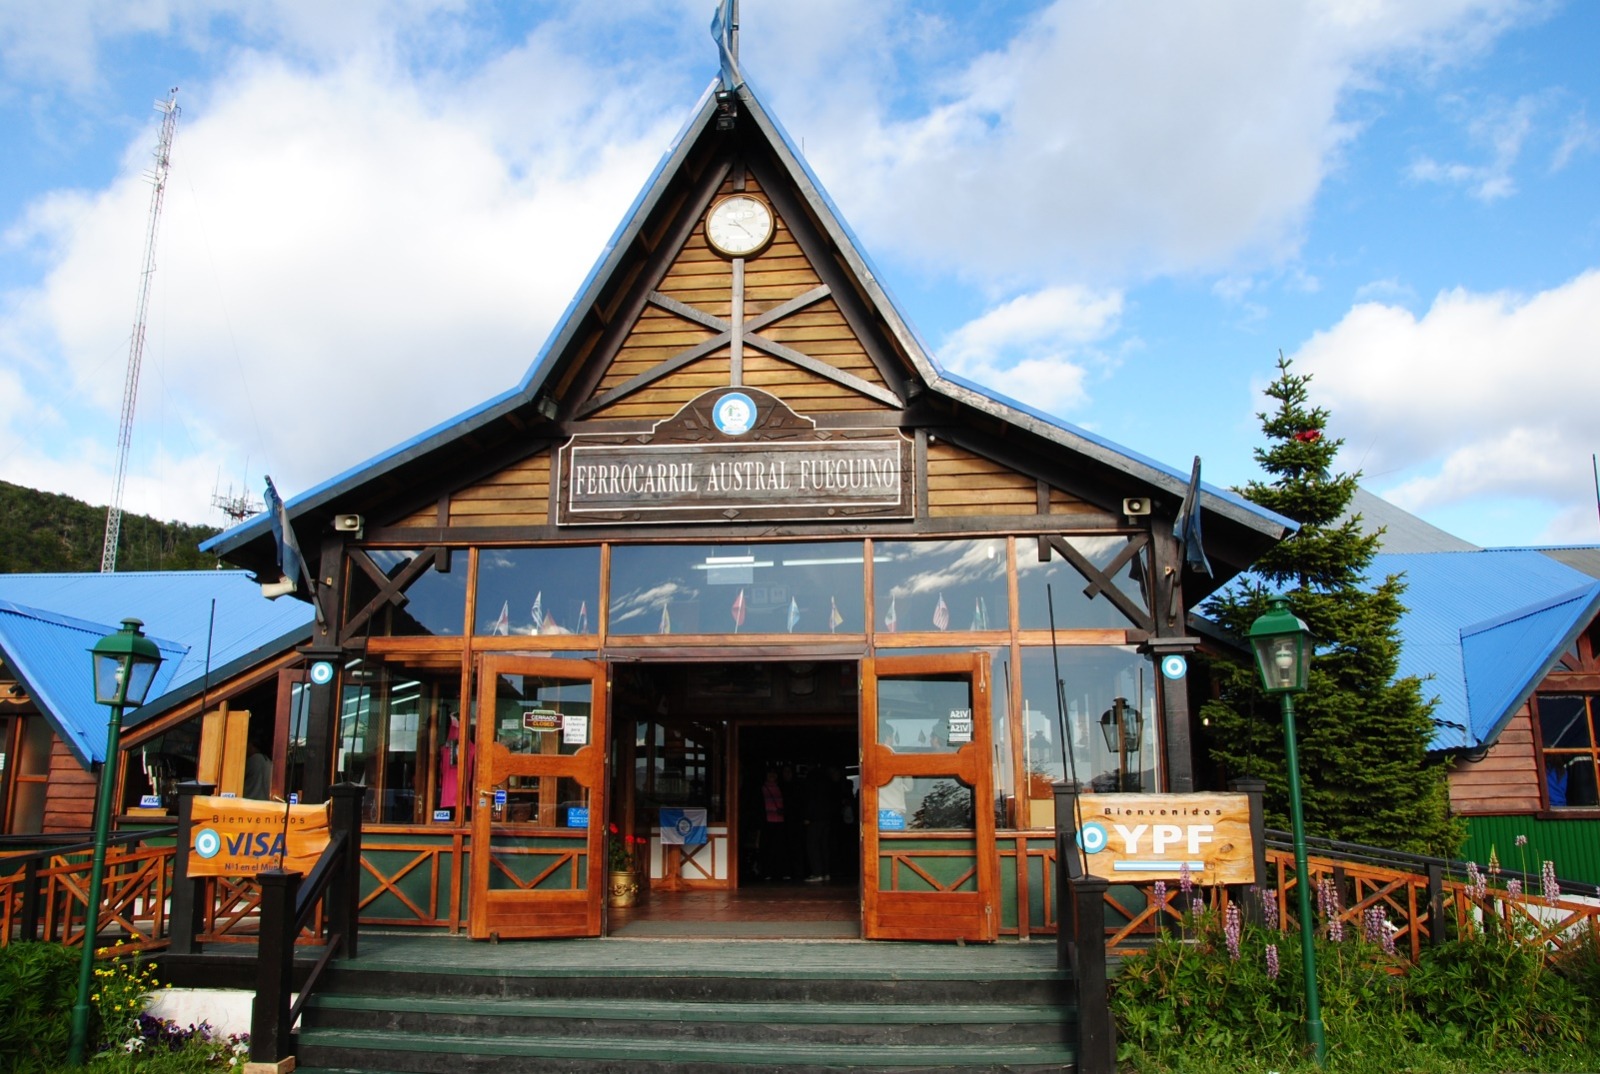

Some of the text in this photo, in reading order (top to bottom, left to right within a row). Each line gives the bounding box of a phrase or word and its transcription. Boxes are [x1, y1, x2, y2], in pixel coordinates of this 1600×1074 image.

[576, 457, 896, 495] FERROCARRIL AUSTRAL FUEGUINO
[1104, 807, 1222, 816] Bienvenidos
[222, 832, 288, 857] VISA
[1113, 824, 1214, 854] YPF
